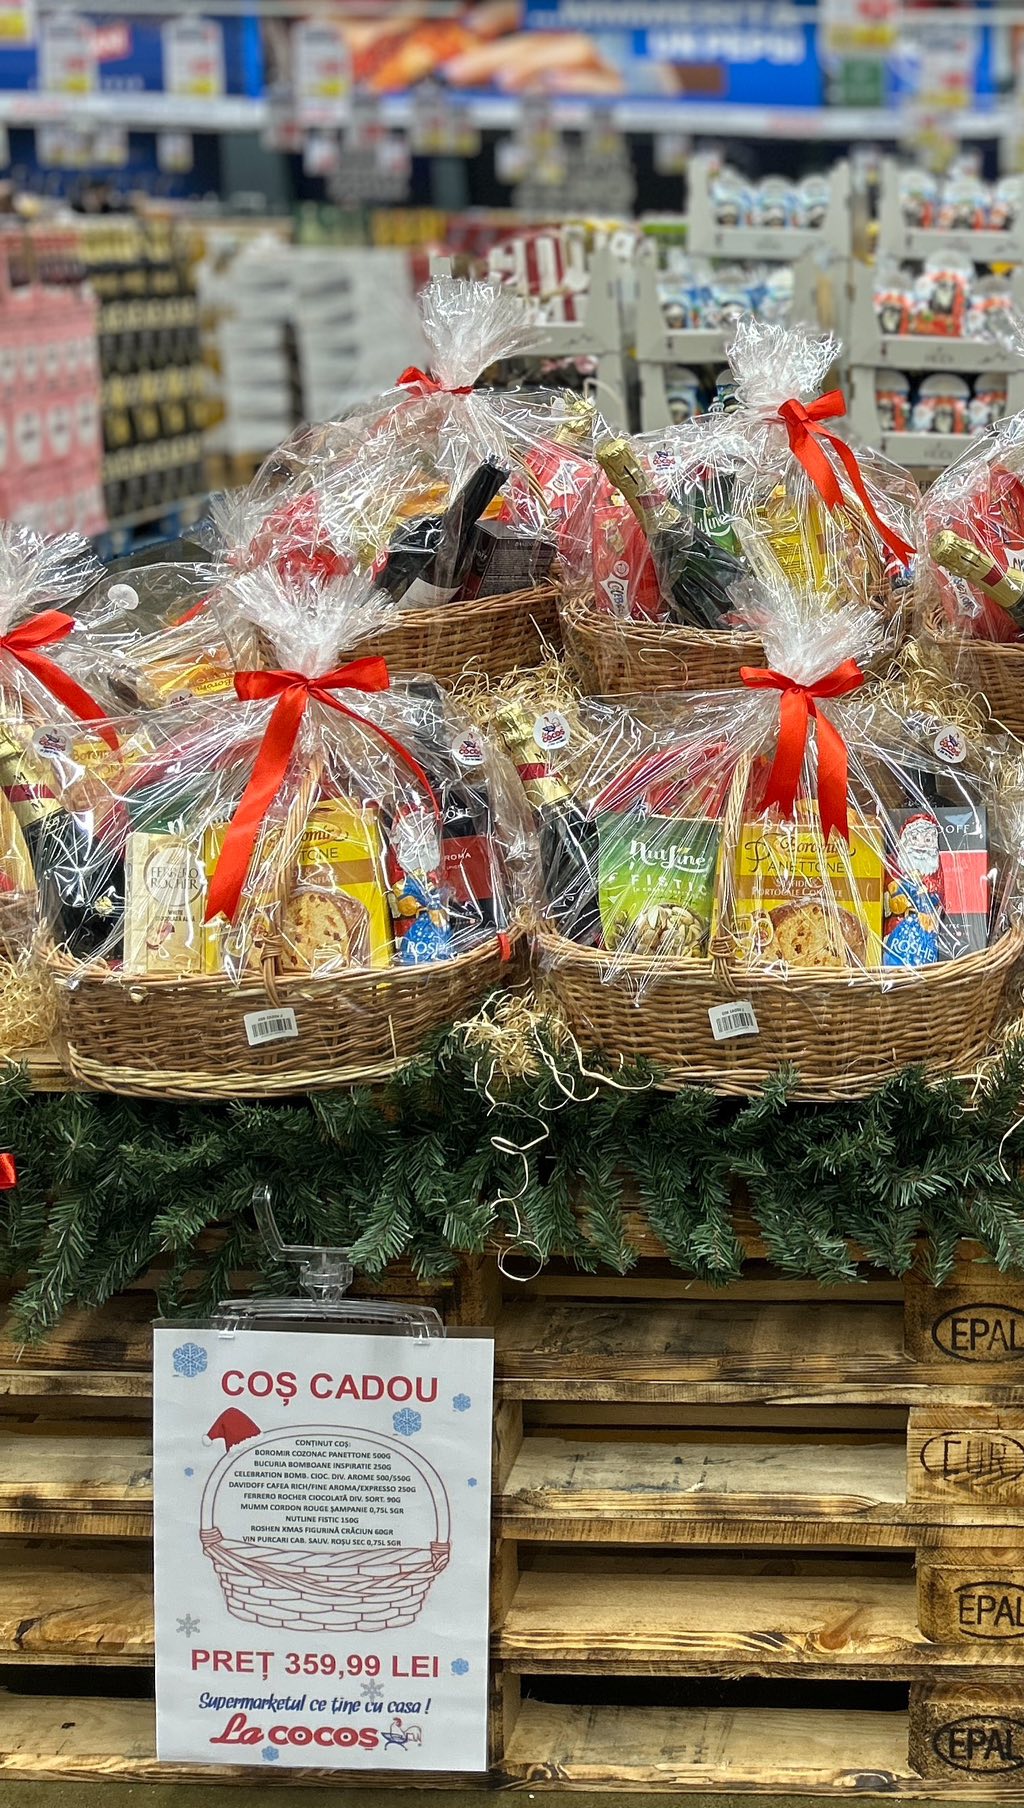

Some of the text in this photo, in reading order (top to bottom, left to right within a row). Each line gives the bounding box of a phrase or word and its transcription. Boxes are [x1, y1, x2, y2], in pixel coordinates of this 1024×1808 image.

[890, 938, 936, 962] ROSHE
[222, 1370, 438, 1406] COȘ CADOU
[291, 1450, 327, 1458] COZONAC
[328, 1451, 371, 1459] PANETTONE
[254, 1460, 286, 1468] BUCURIA
[288, 1461, 331, 1469] BOMBOANE
[333, 1462, 372, 1470] INSPIRATIE
[234, 1471, 283, 1479] CELEBRATION
[228, 1481, 265, 1489] DAVIDOFF
[266, 1482, 289, 1490] CAFEA
[278, 1493, 307, 1501] ROCHER
[270, 1504, 301, 1512] CORDON
[285, 1515, 316, 1523] NUTLINE
[250, 1525, 280, 1533] ROSHEN
[374, 1528, 393, 1536] 60GR
[257, 1536, 289, 1544] PURCARI
[191, 1649, 439, 1680] PREȚ 359,99 LEI
[198, 1692, 307, 1712] Supermarketul
[309, 1698, 328, 1712] ce
[365, 1699, 382, 1713] cu
[387, 1699, 421, 1714] casa
[209, 1713, 264, 1745] La
[949, 1727, 1024, 1761] EPAL
